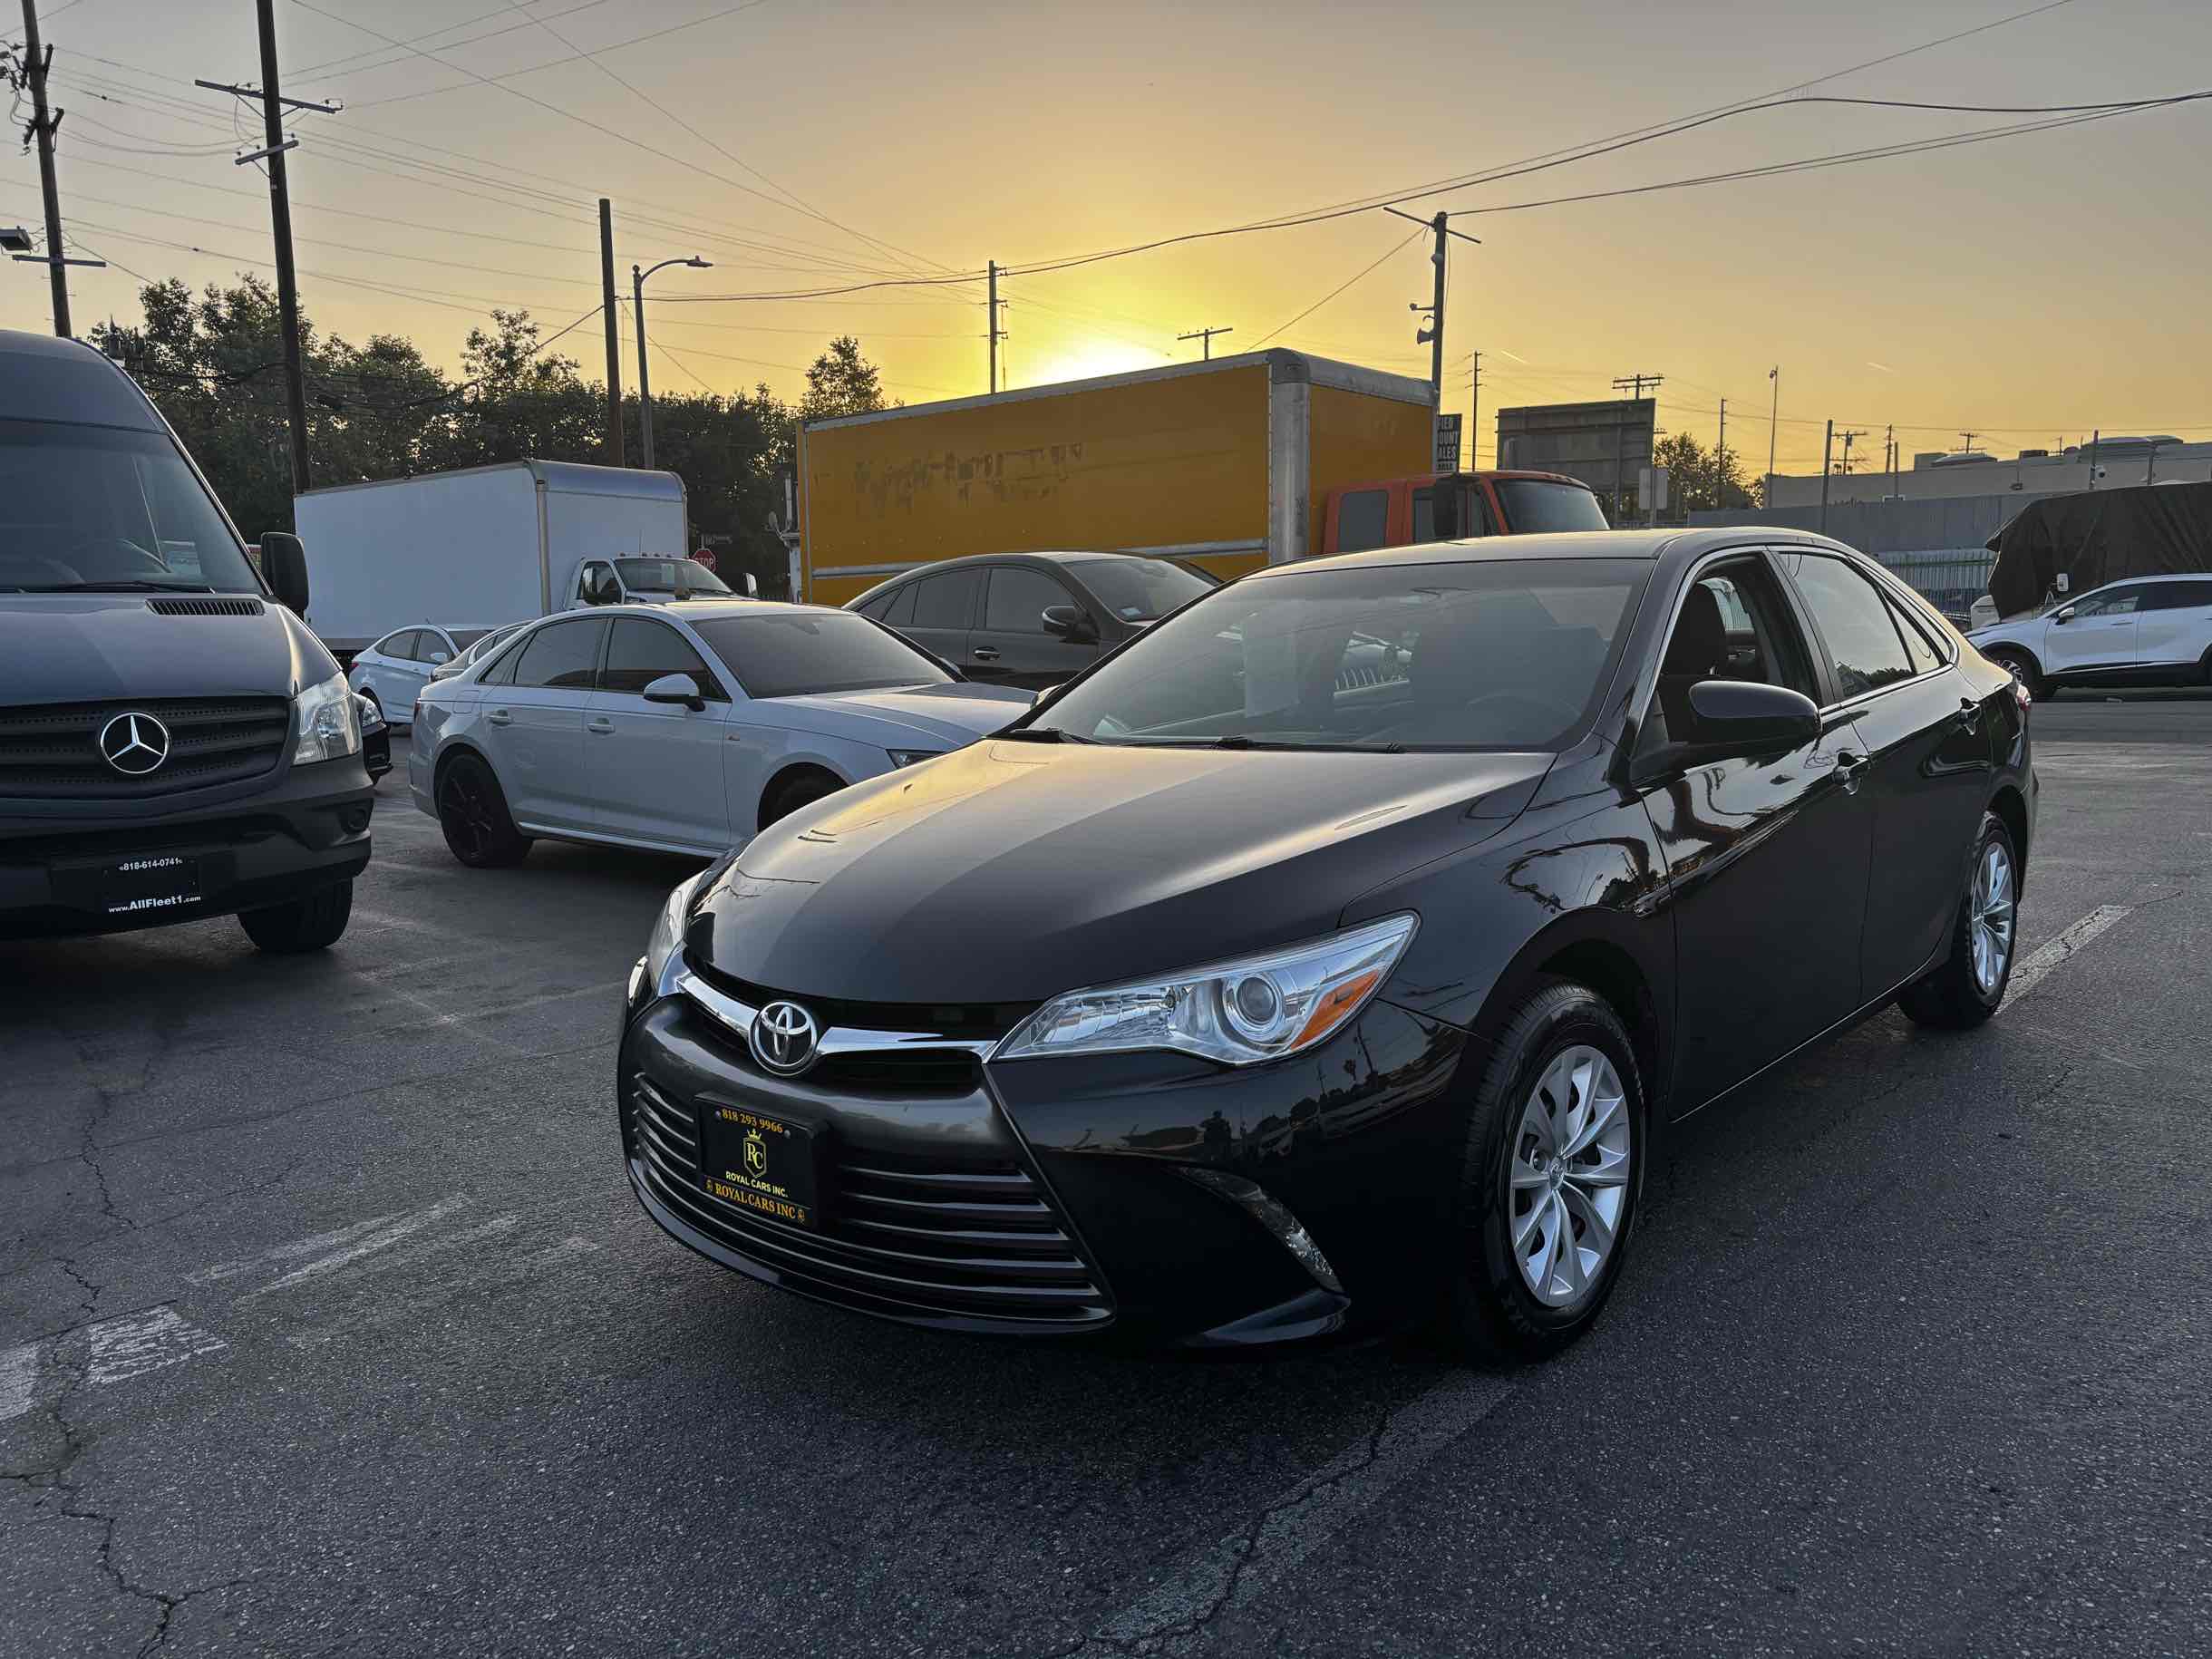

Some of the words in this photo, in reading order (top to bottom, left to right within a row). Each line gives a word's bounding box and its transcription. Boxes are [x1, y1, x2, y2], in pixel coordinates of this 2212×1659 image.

[108, 894, 201, 913] www.AllFleet1.com
[722, 1108, 738, 1122] 818
[739, 1113, 757, 1127] 293
[759, 1118, 783, 1133] 9966
[725, 1170, 750, 1186] ROYAL
[751, 1179, 771, 1193] CARS
[715, 1182, 748, 1204] ROYAL
[748, 1193, 776, 1212] CARS
[775, 1202, 796, 1219] INC
